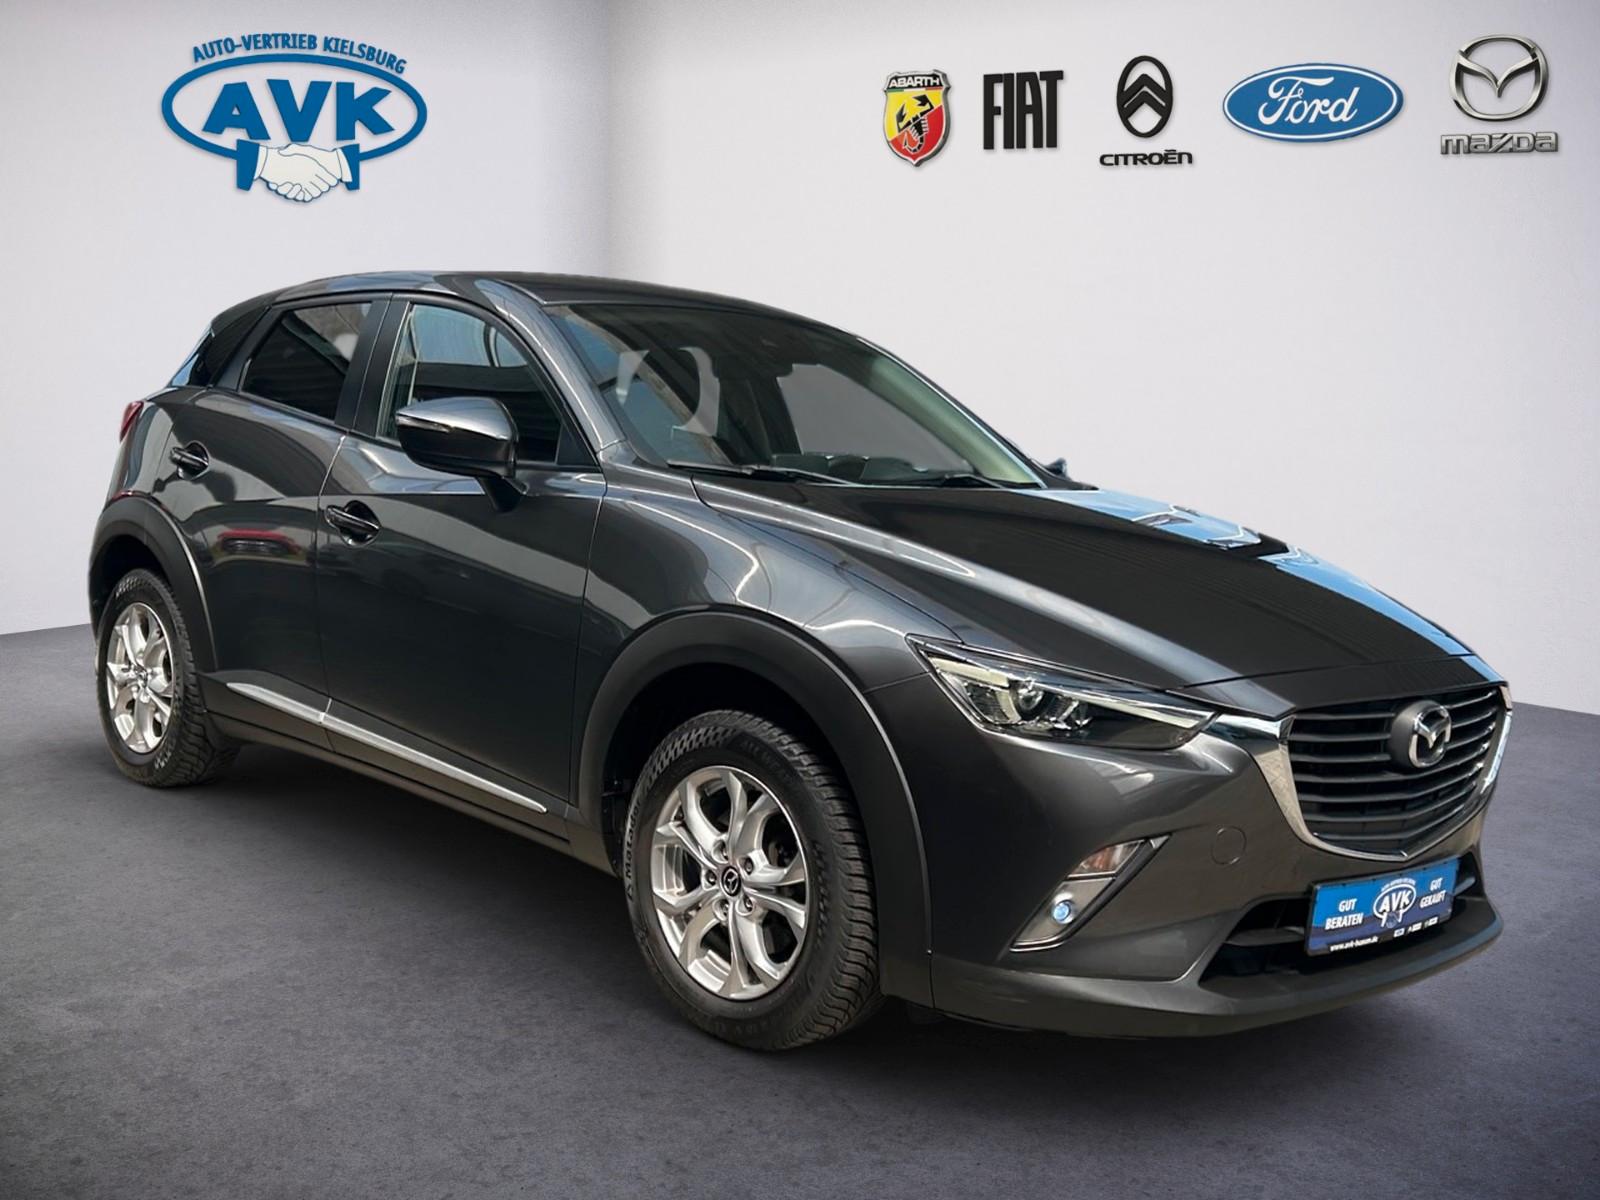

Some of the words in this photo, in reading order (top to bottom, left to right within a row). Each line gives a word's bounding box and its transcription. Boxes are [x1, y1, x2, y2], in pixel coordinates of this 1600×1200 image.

[193, 33, 318, 63] AUTO-VERTRIEB
[323, 36, 408, 74] KIELSBURG
[888, 75, 941, 88] ABARTH
[202, 78, 396, 142] AVK
[983, 70, 1064, 150] FIAT
[1258, 76, 1360, 125] Ford
[1429, 877, 1443, 891] GUT
[1338, 898, 1358, 913] GUT
[1379, 890, 1412, 913] AVK
[1325, 912, 1364, 930] BERATEN
